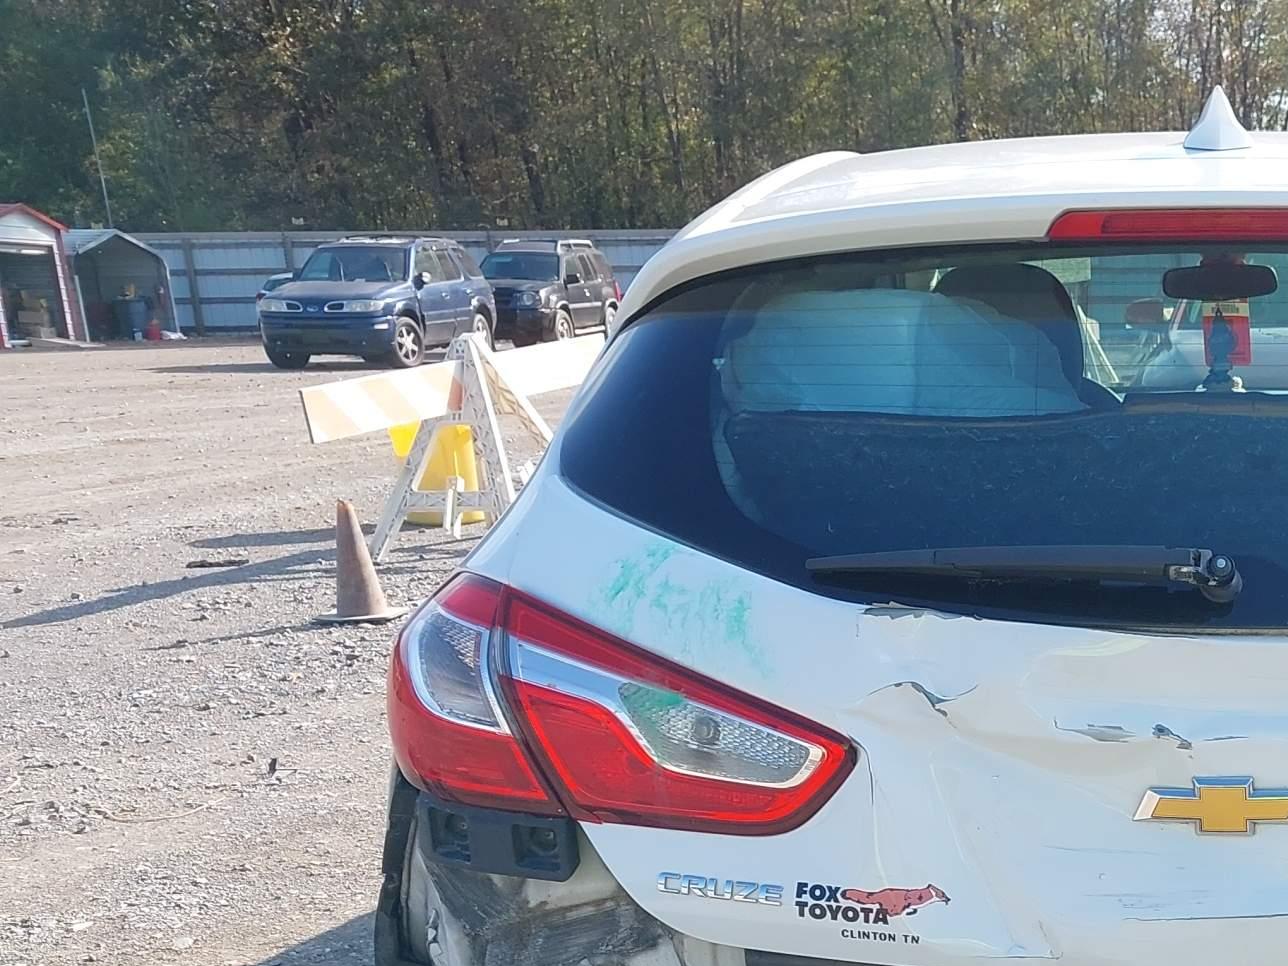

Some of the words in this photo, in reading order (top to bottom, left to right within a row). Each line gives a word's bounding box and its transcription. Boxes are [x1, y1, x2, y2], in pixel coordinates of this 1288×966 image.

[657, 871, 784, 906] CRUZE
[795, 881, 841, 903] FOX
[795, 901, 889, 925] TOYOTA
[841, 929, 896, 942] CLINTON
[903, 934, 920, 944] TN
